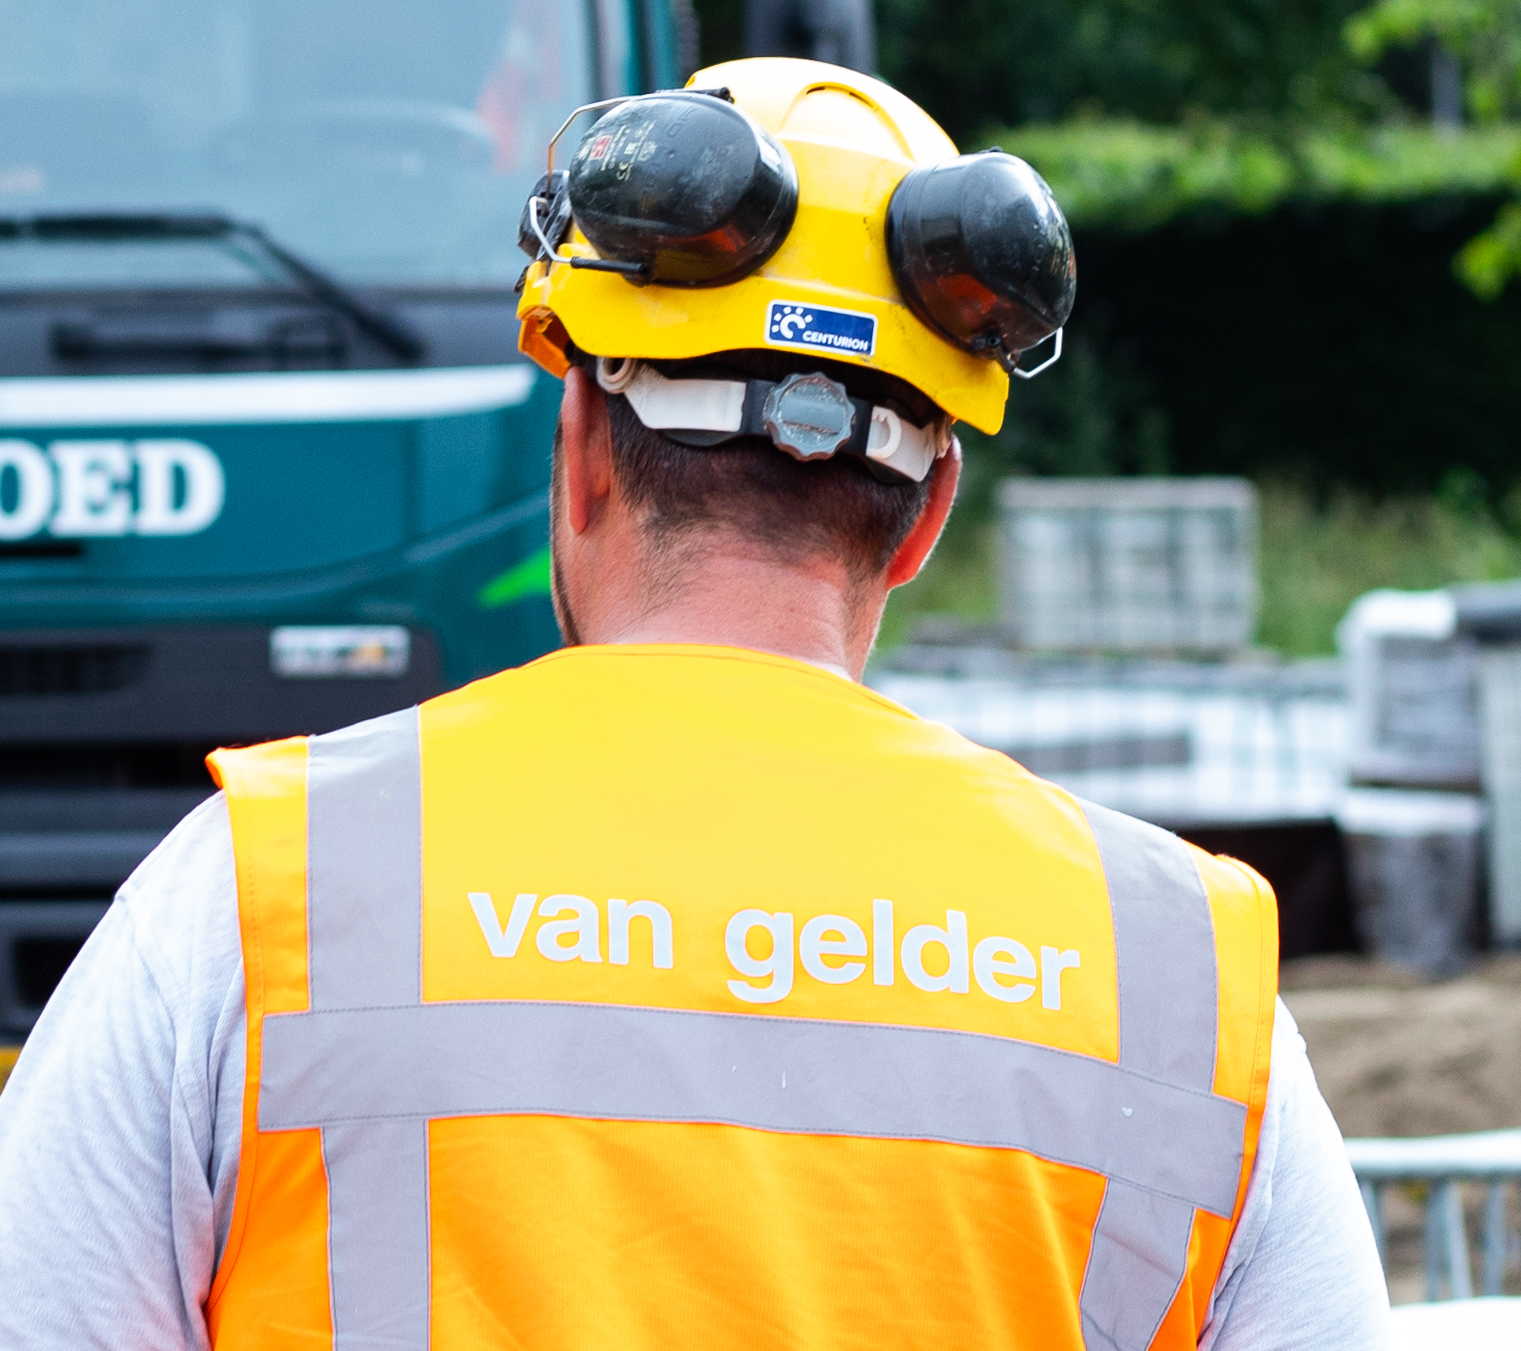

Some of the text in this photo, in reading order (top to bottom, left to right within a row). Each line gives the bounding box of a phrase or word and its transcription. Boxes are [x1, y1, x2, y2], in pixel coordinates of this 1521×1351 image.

[802, 330, 868, 351] CENTURION
[467, 892, 1080, 1010] van gelder
